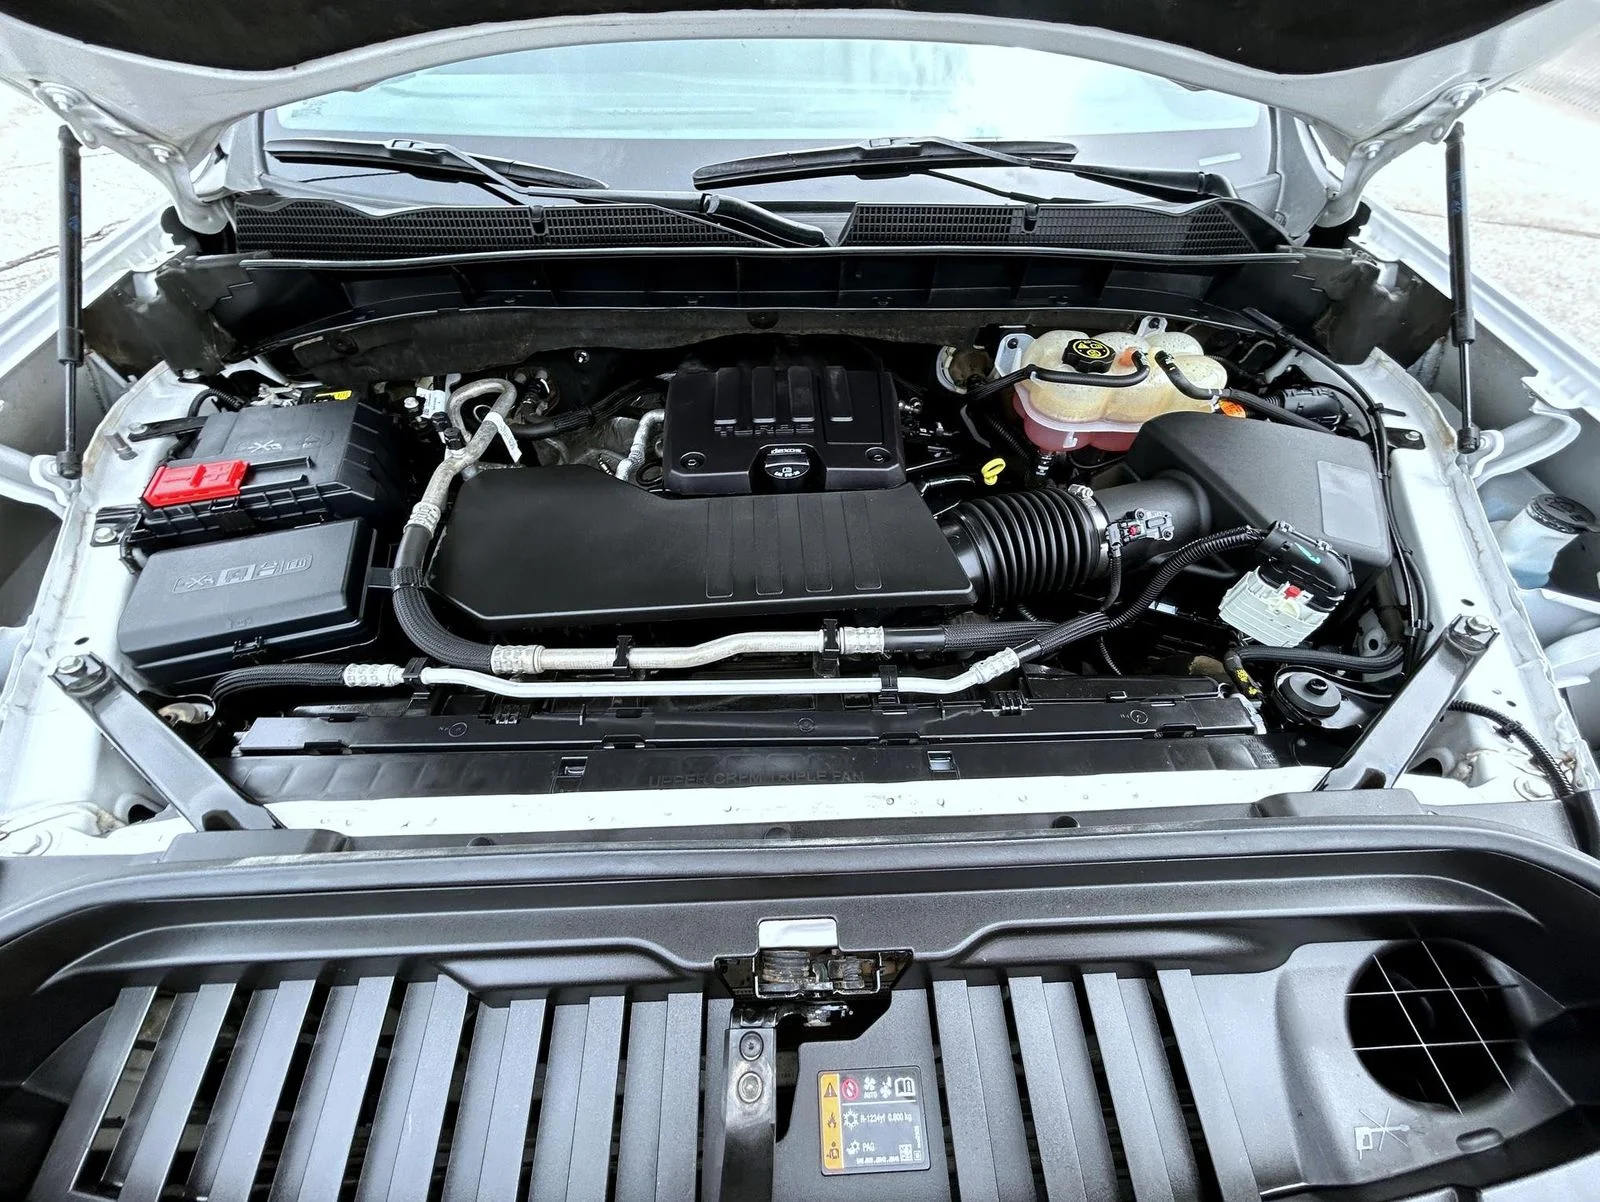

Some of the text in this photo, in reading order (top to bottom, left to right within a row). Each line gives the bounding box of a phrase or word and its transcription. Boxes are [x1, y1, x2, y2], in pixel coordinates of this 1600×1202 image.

[648, 773, 710, 787] UPPER
[770, 770, 828, 784] TRIPLE
[832, 770, 865, 783] FAN
